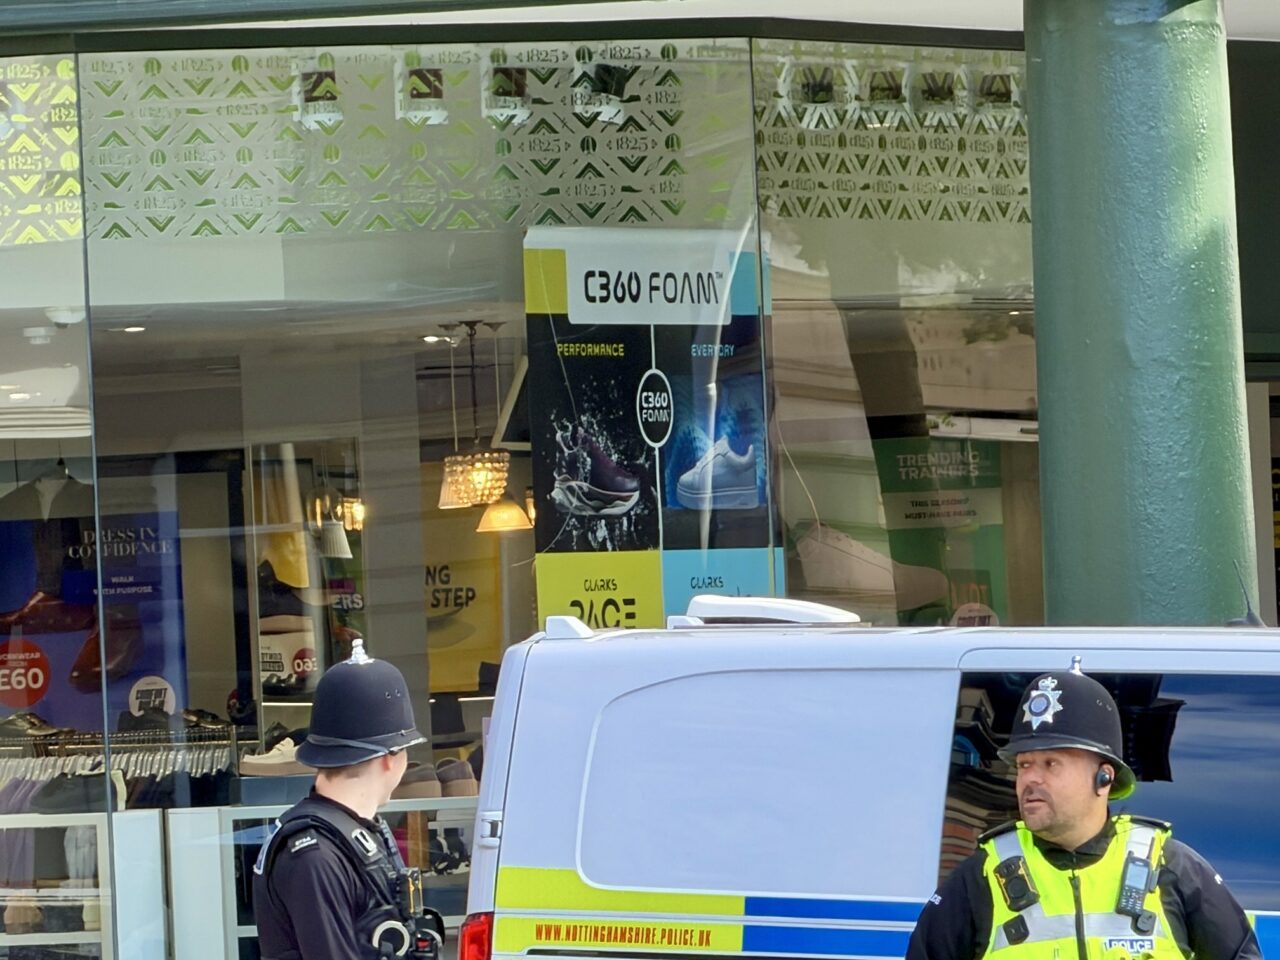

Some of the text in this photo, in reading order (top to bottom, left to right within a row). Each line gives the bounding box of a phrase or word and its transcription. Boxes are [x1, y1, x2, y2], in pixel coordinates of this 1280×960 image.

[526, 48, 559, 64] 1825
[609, 45, 642, 60] 1825
[7, 63, 41, 80] 1825
[528, 138, 561, 153] 1825
[616, 135, 648, 151] 1825
[8, 155, 42, 170] 1825
[584, 270, 641, 303] C360
[556, 343, 625, 357] PERFORMANCE
[641, 391, 669, 409] C360
[425, 564, 451, 587] NG
[690, 575, 724, 589] CLARKS
[583, 578, 618, 592] CLARKS
[431, 587, 476, 609] STEP
[535, 923, 712, 947] WWW.NOTTINGHAMSHIRE.POLICE.UK
